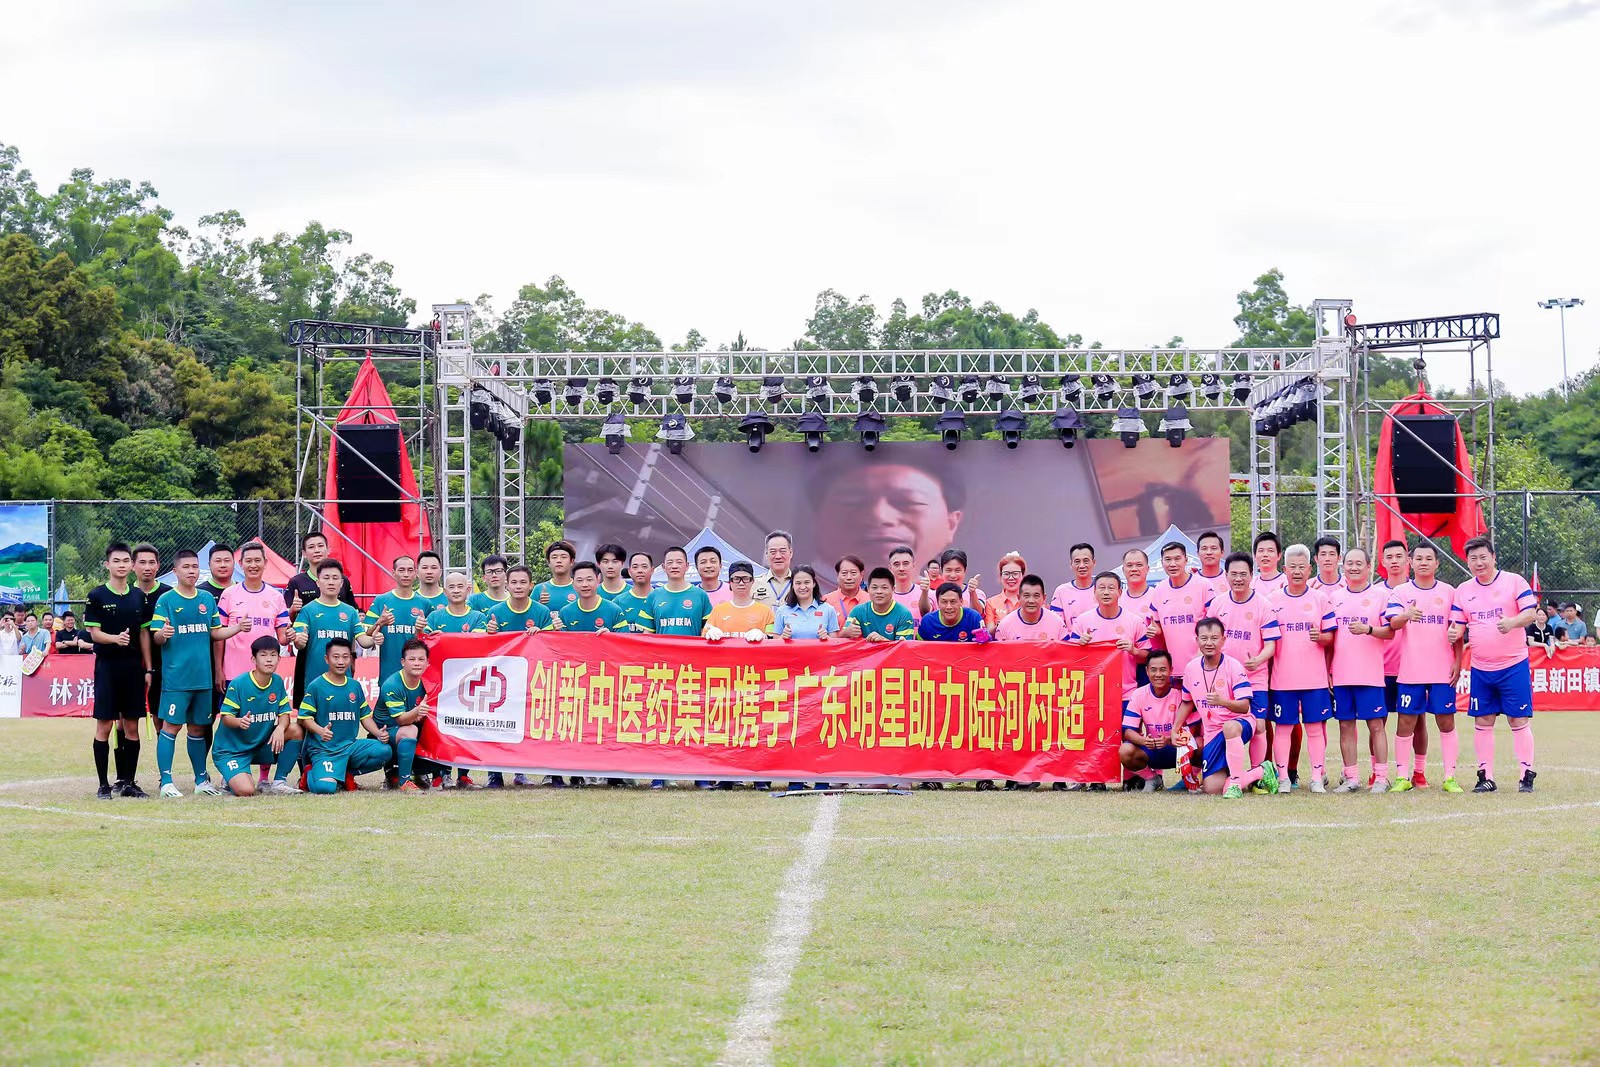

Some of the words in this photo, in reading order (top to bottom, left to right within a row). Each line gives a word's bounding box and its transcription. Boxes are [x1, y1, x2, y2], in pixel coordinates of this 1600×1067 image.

[660, 617, 692, 628] 陆河联队
[1163, 613, 1195, 625] 广东明星
[529, 660, 1105, 751] 创新中医药集团携手广东明星助力陆河村超！
[1400, 694, 1412, 708] 19
[168, 703, 177, 716] 8
[1274, 703, 1282, 718] 13
[444, 715, 516, 730] 创新中医药集团
[226, 760, 239, 771] 15
[322, 760, 334, 773] 12
